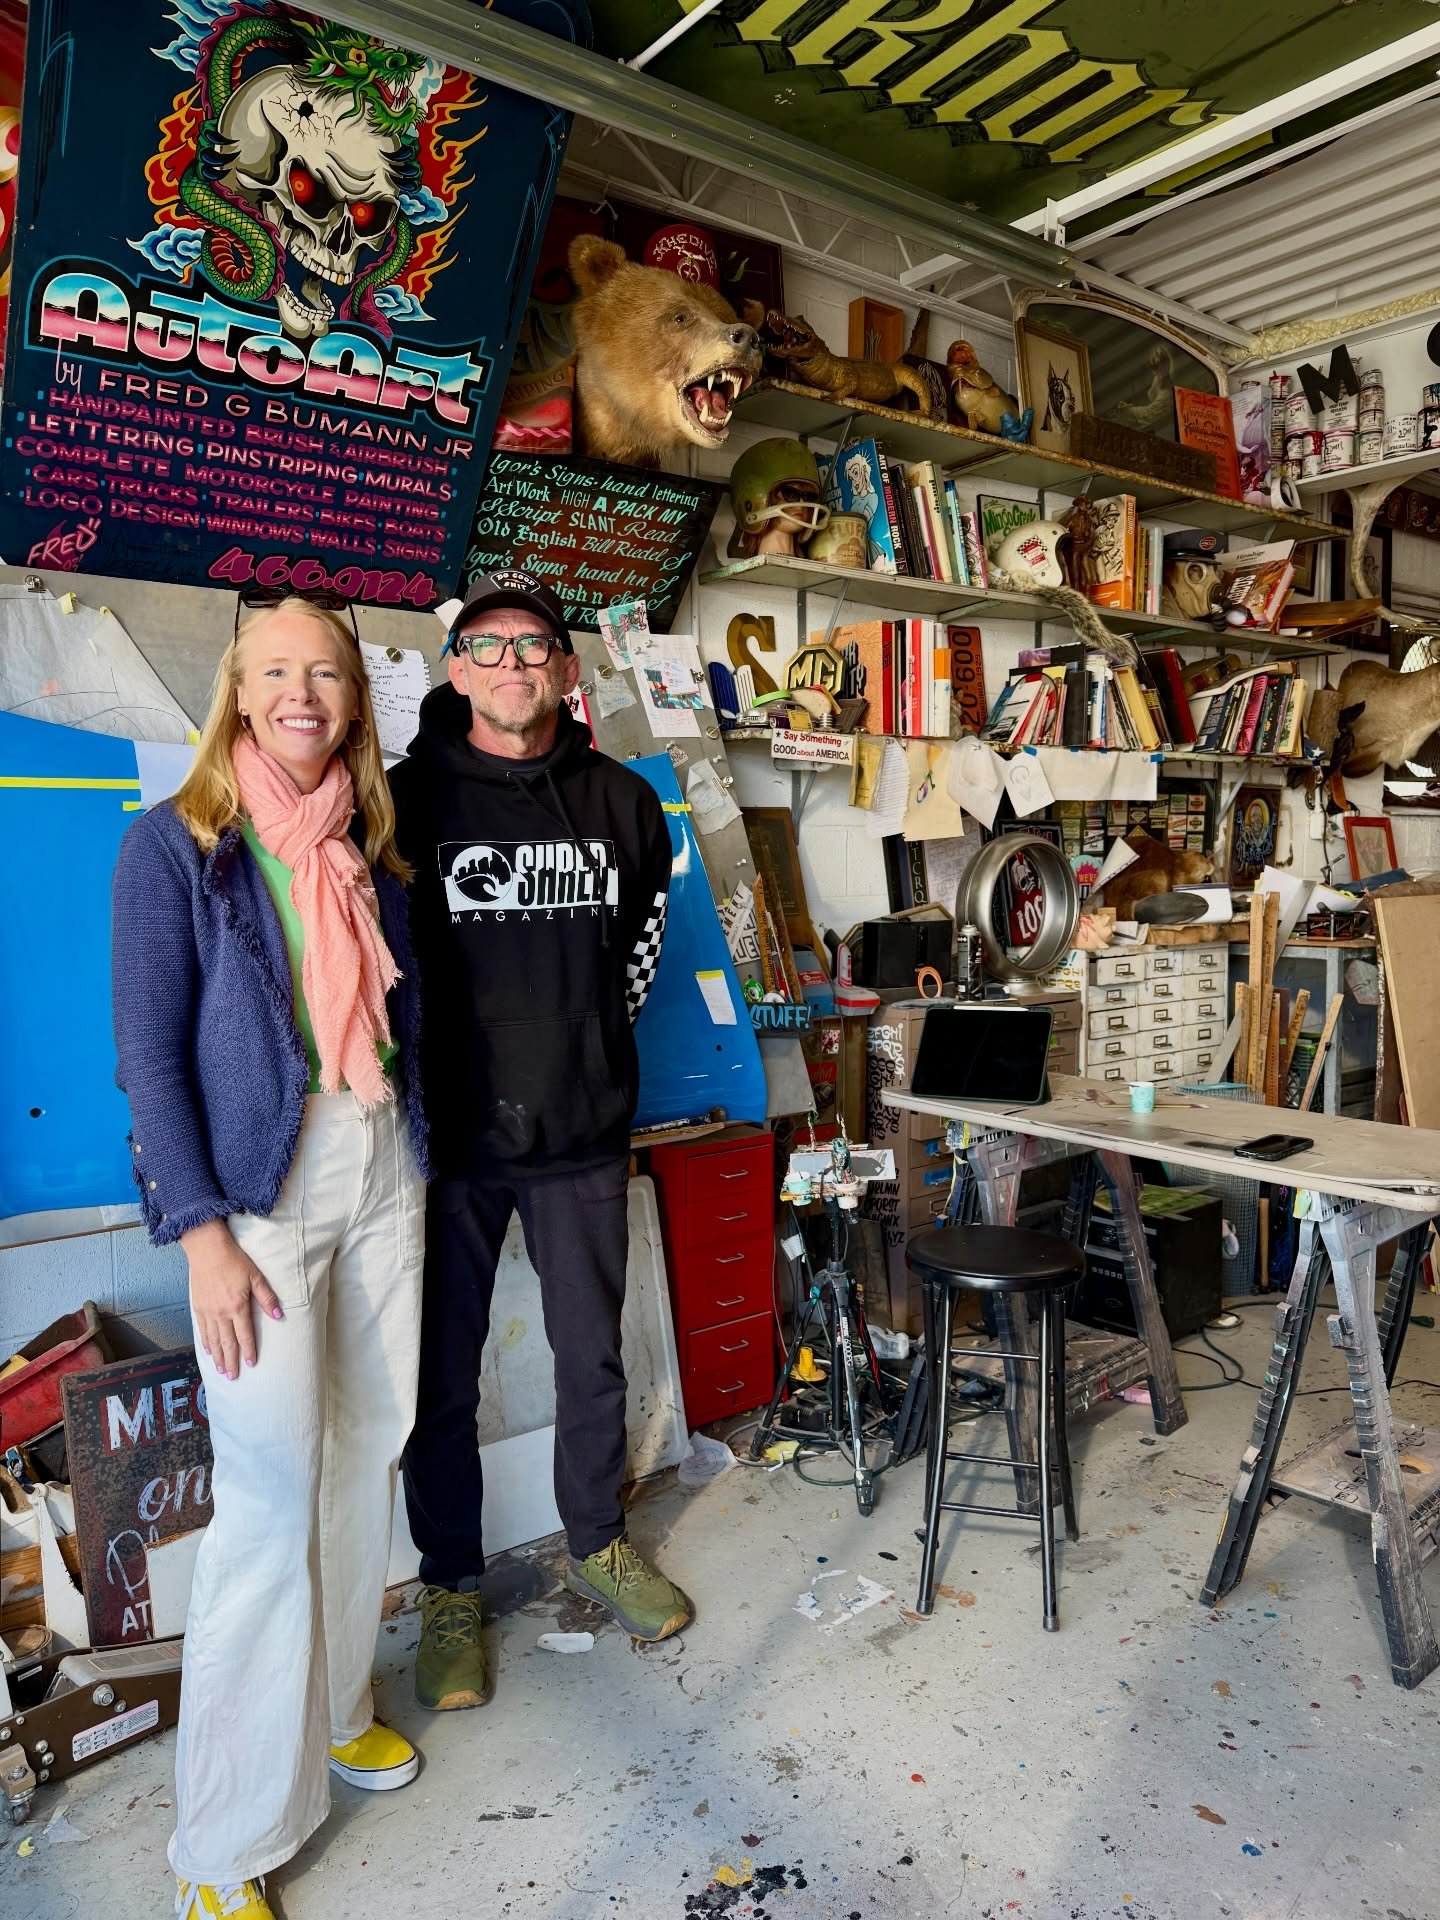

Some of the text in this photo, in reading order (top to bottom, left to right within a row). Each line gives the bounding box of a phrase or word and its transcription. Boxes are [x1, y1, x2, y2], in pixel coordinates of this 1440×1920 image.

[41, 273, 484, 425] AutoArt
[49, 388, 236, 438] HANDPAINTED
[245, 424, 325, 456] BRUSH
[341, 443, 450, 476] AIRBRUSH
[99, 371, 209, 409] FRED
[225, 394, 251, 418] G
[265, 399, 427, 451] BUMANN
[432, 438, 473, 461] JR
[15, 435, 440, 521] COMPLETE MOTORCYCLE PAINTING
[28, 411, 452, 501] LETTERING PINSTRIPING MURALS
[32, 464, 447, 543] CARS TRUCKS TRAILERS BIKES BOATS
[484, 476, 688, 526] Art Work HIGH A PACK MY
[489, 453, 542, 477] Igor's
[600, 475, 650, 498] hand
[652, 484, 699, 511] lettering
[878, 454, 902, 550] ART OF MODERN ROCK
[24, 485, 442, 564] LOGO DESIGN WINDOWS WALLS SIGNS
[477, 516, 510, 537] Old
[512, 523, 577, 550] English
[582, 536, 615, 555] Bill
[568, 511, 617, 534] SLANT
[617, 521, 681, 544] Read
[464, 545, 513, 570] Igor's
[521, 553, 568, 577] Signs
[575, 562, 622, 584] hand
[496, 572, 510, 581] DO
[512, 572, 536, 586] GOOD
[504, 581, 527, 591] SHIT
[789, 653, 835, 692] MG
[773, 744, 850, 761] GOOD about AMERICA
[783, 731, 842, 748] Say Something
[452, 905, 619, 924] MAGAZINE
[751, 1005, 812, 1030] STUFF!
